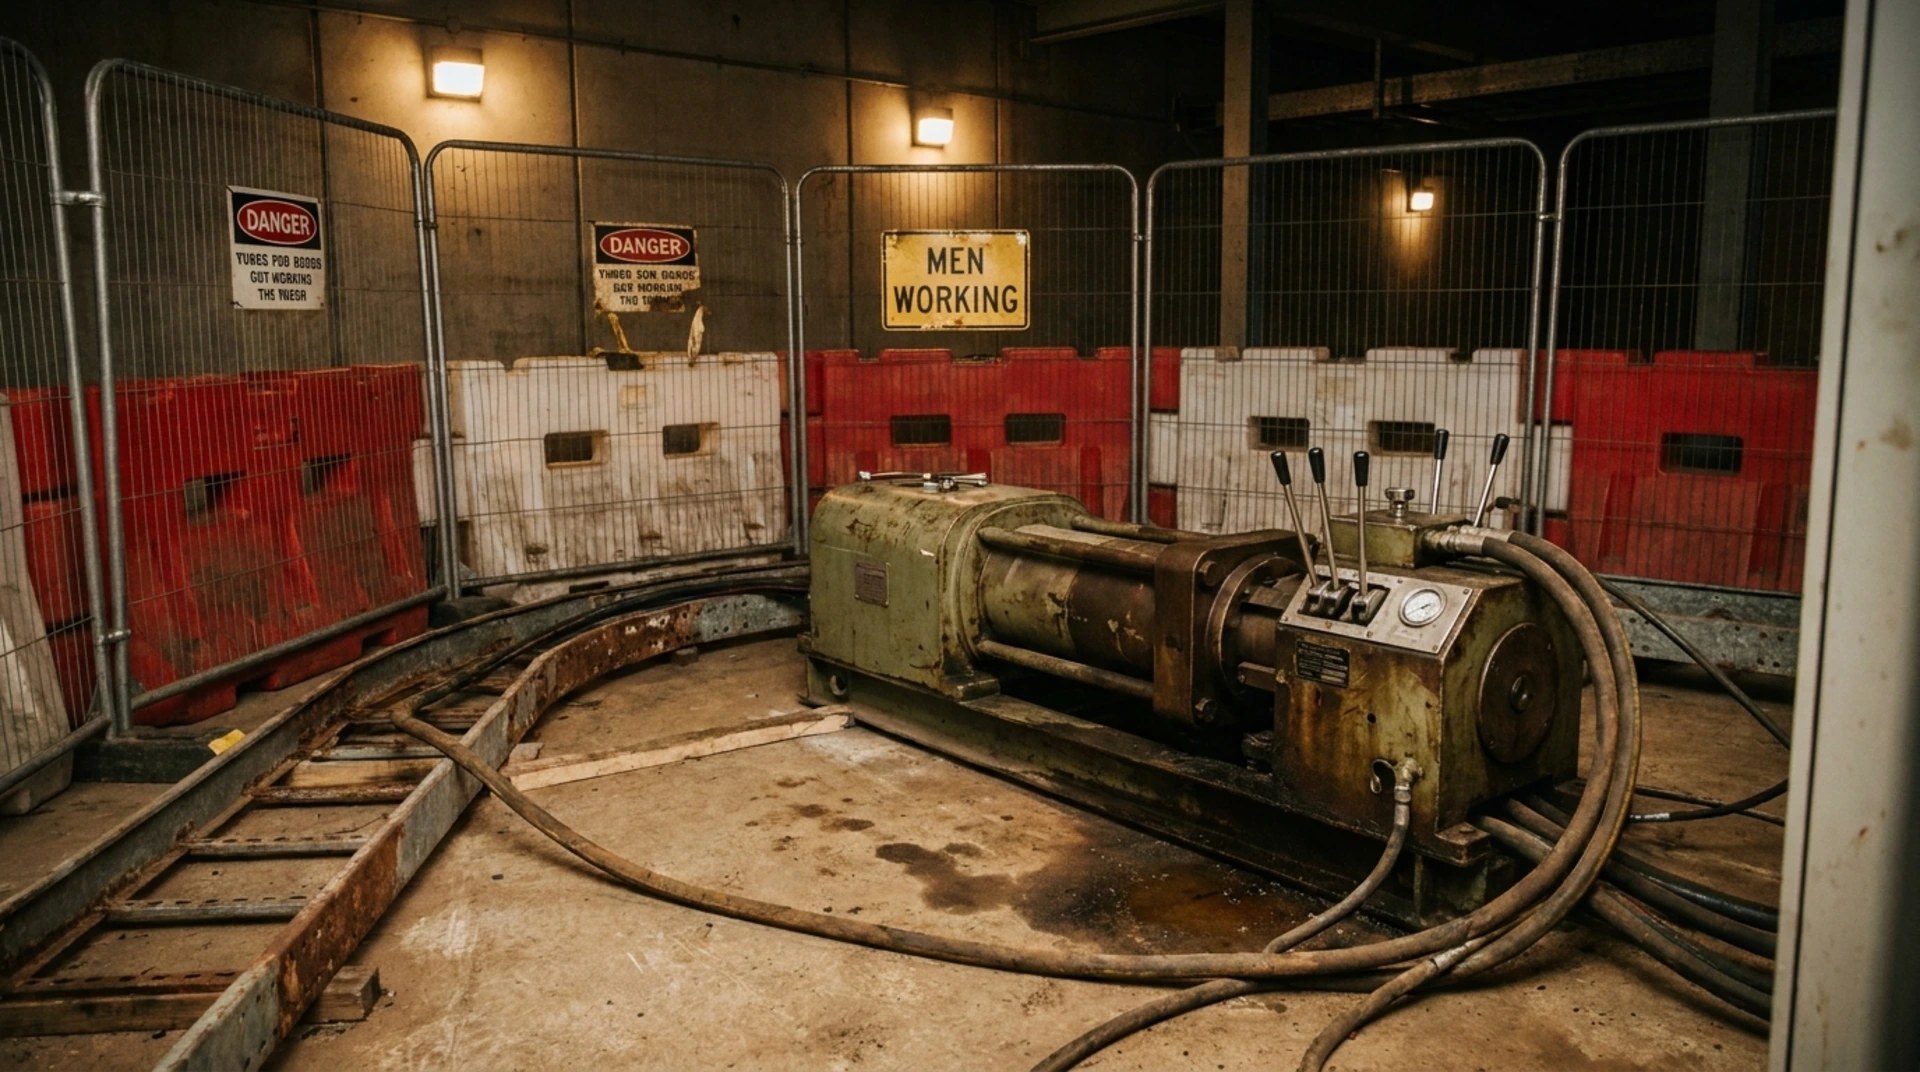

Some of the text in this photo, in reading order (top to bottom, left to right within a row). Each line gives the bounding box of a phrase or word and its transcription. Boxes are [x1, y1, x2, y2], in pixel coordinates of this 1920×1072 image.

[247, 209, 310, 236] DANGER
[610, 237, 682, 255] DANGER
[928, 247, 983, 275] MEN
[637, 270, 657, 280] SON
[893, 285, 1018, 314] WORKING
